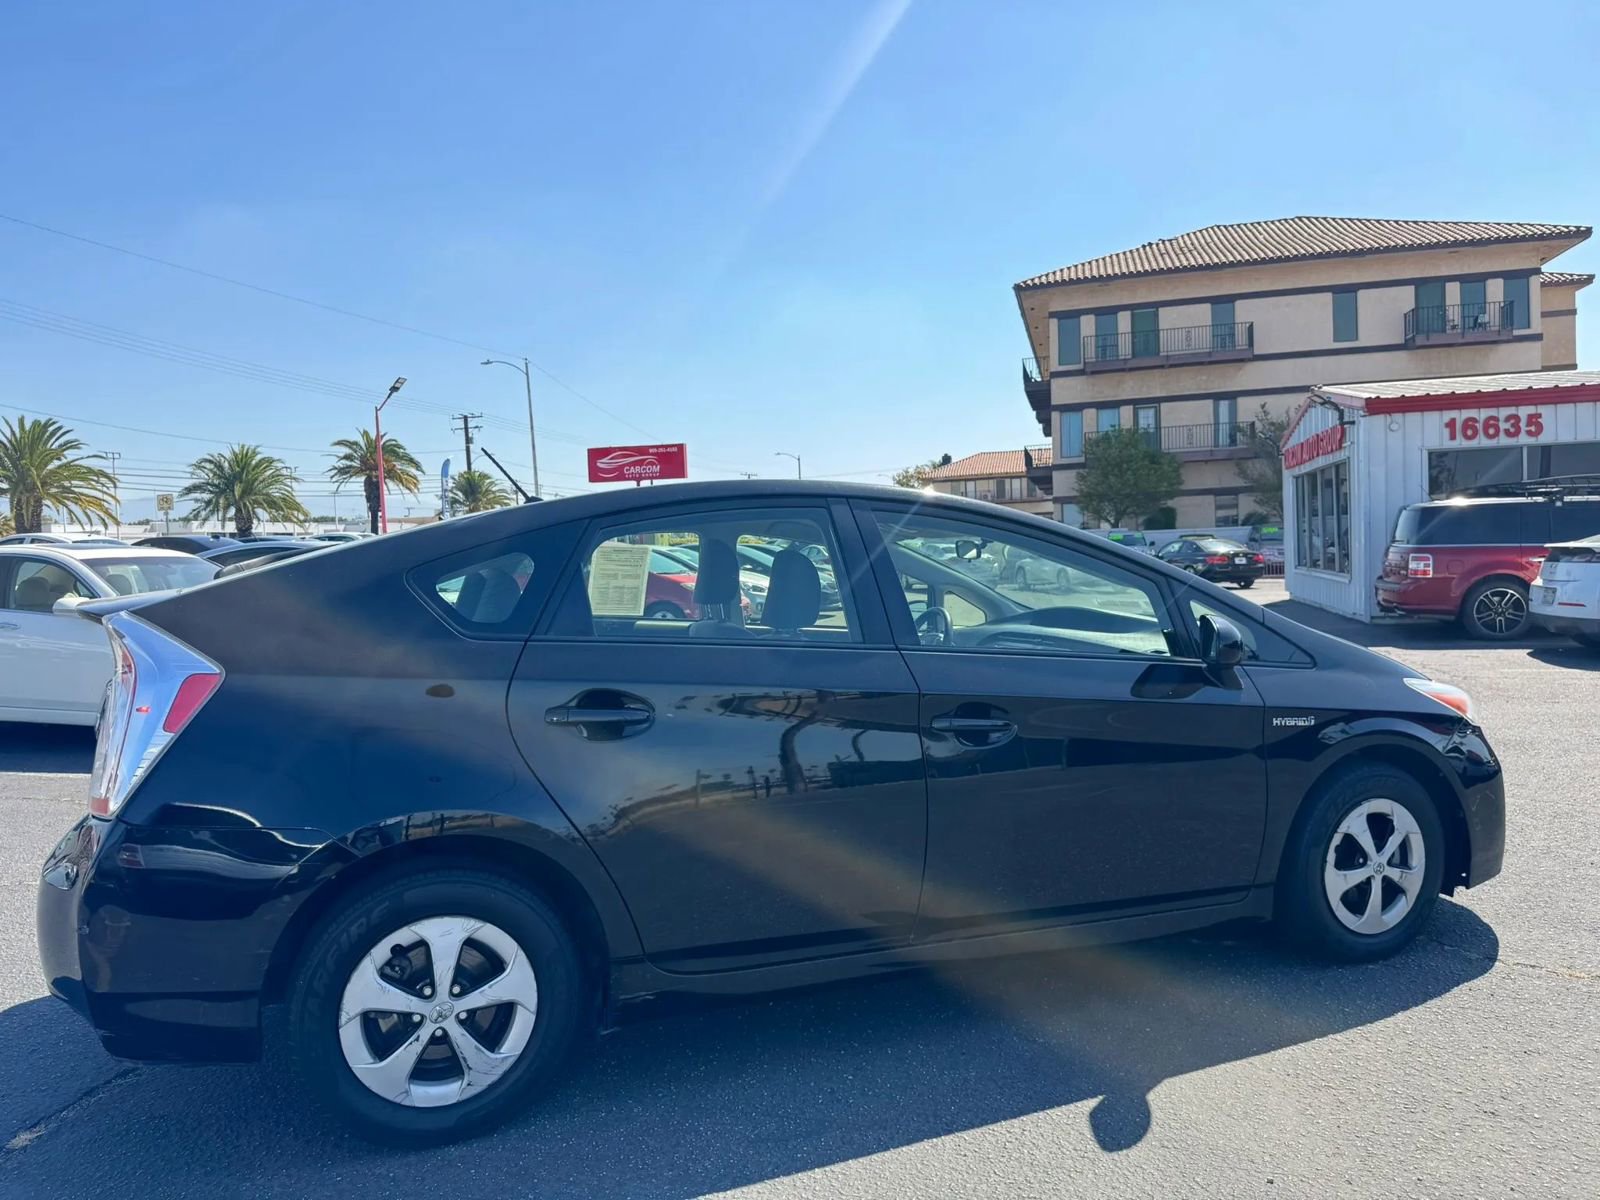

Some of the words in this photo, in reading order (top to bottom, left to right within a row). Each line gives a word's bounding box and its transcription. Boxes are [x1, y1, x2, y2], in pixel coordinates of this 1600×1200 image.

[1444, 413, 1544, 441] 16635
[1302, 435, 1318, 463] AUTO
[1318, 425, 1342, 456] GROUP
[624, 465, 660, 474] CARCOM
[1272, 717, 1308, 727] HYBRID
